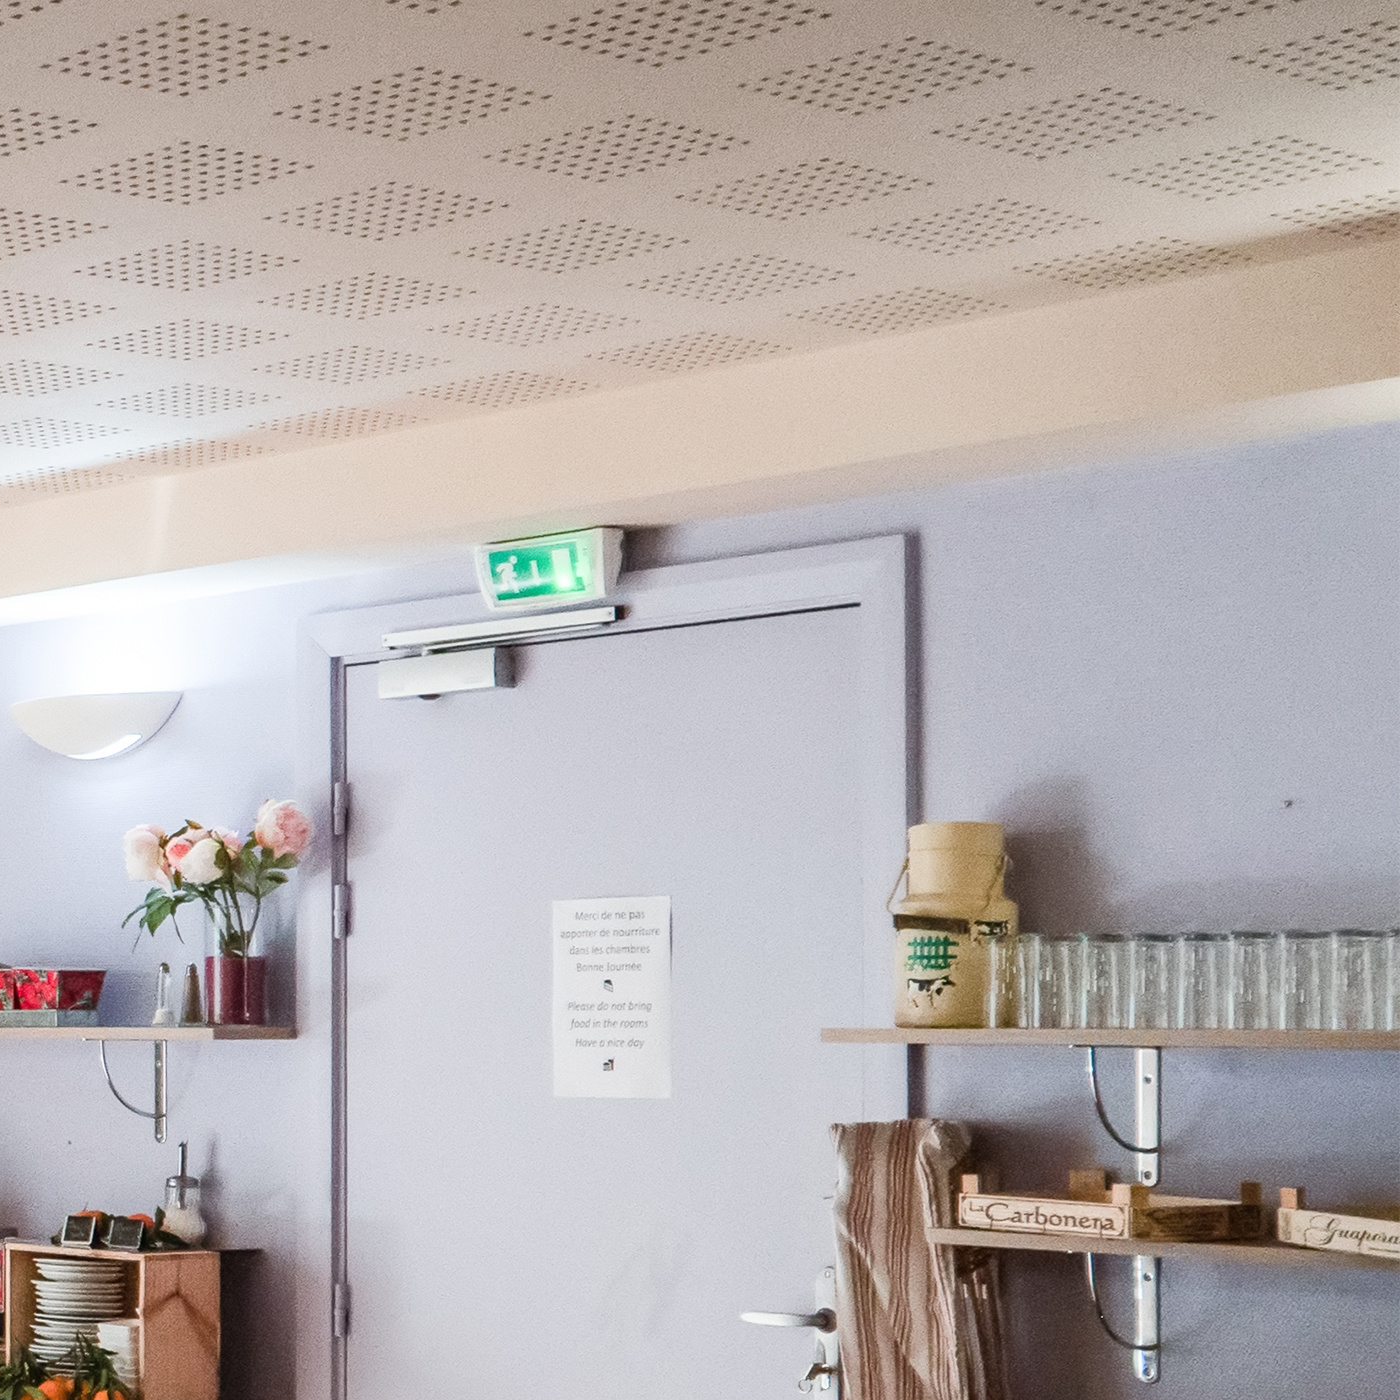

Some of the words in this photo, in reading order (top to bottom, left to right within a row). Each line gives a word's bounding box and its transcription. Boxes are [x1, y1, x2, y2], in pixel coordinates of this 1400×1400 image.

[575, 911, 599, 921] Merci
[601, 910, 613, 920] de
[615, 911, 627, 920] ne
[629, 911, 646, 921] pas
[560, 928, 597, 940] apporter
[599, 928, 610, 938] de
[612, 926, 660, 937] nourriture
[569, 945, 589, 955] dans
[591, 945, 604, 955] les
[605, 943, 651, 955] chambres
[576, 962, 604, 972] Bonne
[567, 1001, 595, 1011] Please
[597, 1001, 609, 1011] do
[611, 1002, 626, 1011] not
[628, 1001, 653, 1013] bring
[569, 1018, 591, 1031] food
[592, 1019, 601, 1028] in
[603, 1018, 618, 1028] the
[620, 1020, 649, 1028] rooms
[575, 1038, 597, 1048] Have
[607, 1038, 625, 1047] nice
[627, 1038, 645, 1049] day
[969, 1201, 984, 1213] La
[985, 1202, 1116, 1231] Carbonera
